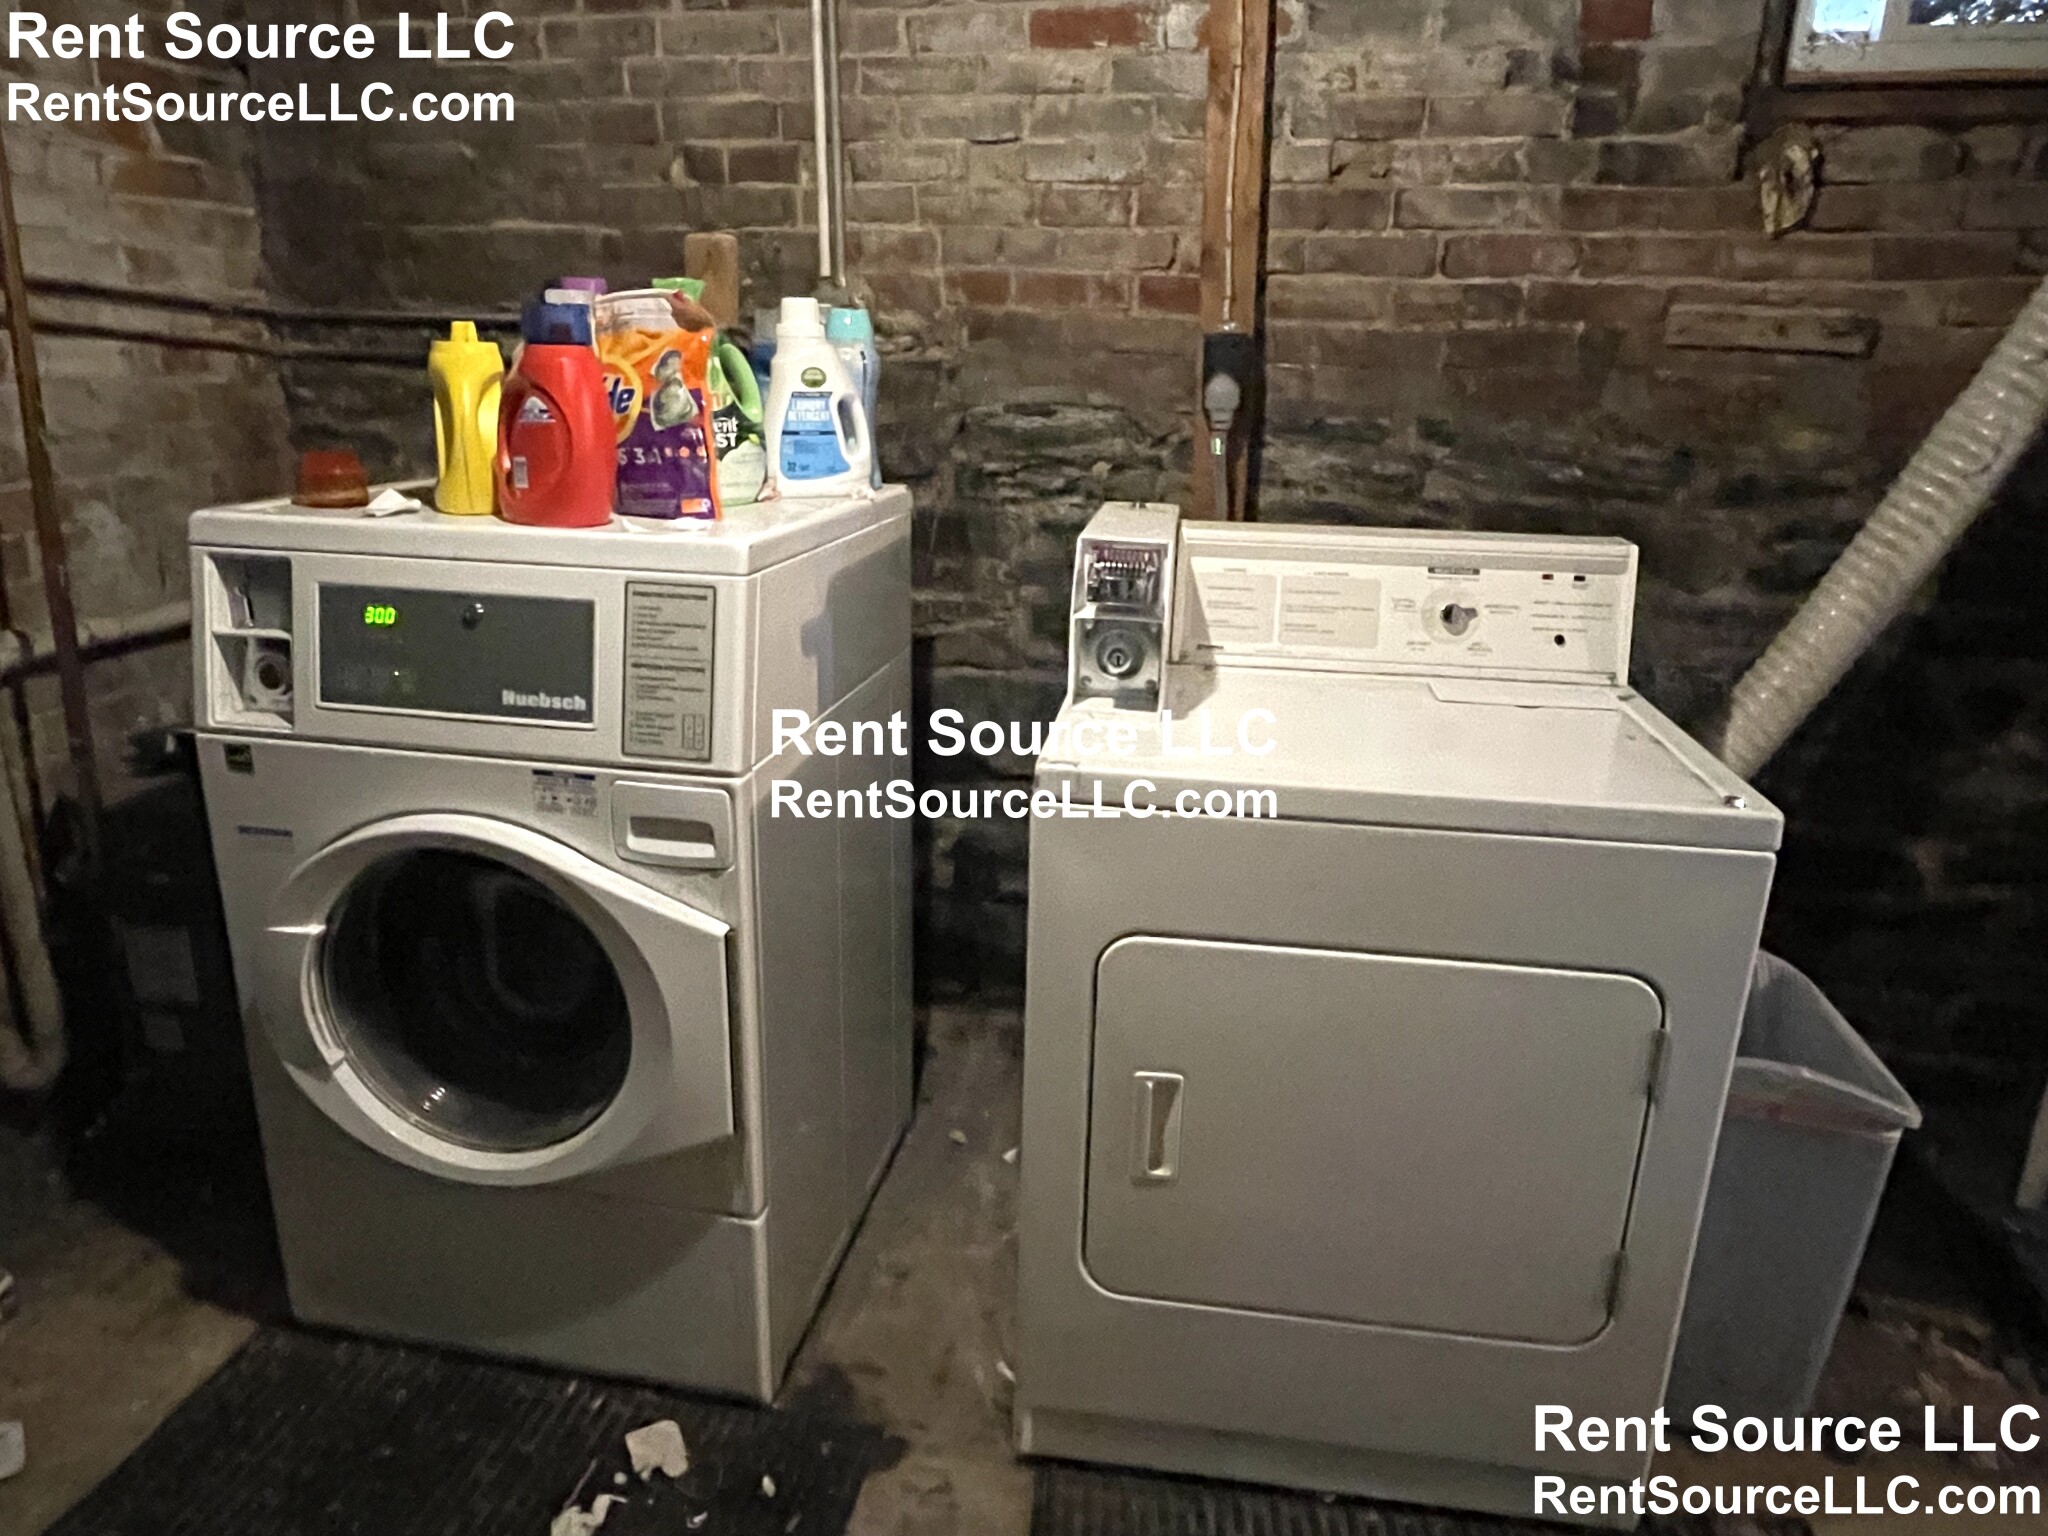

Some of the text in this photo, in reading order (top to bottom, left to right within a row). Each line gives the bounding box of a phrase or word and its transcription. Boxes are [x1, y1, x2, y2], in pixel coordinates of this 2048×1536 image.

[602, 376, 636, 414] de
[713, 416, 738, 433] ent
[715, 433, 737, 448] ST
[364, 606, 396, 625] 300
[502, 689, 587, 711] Huebsch
